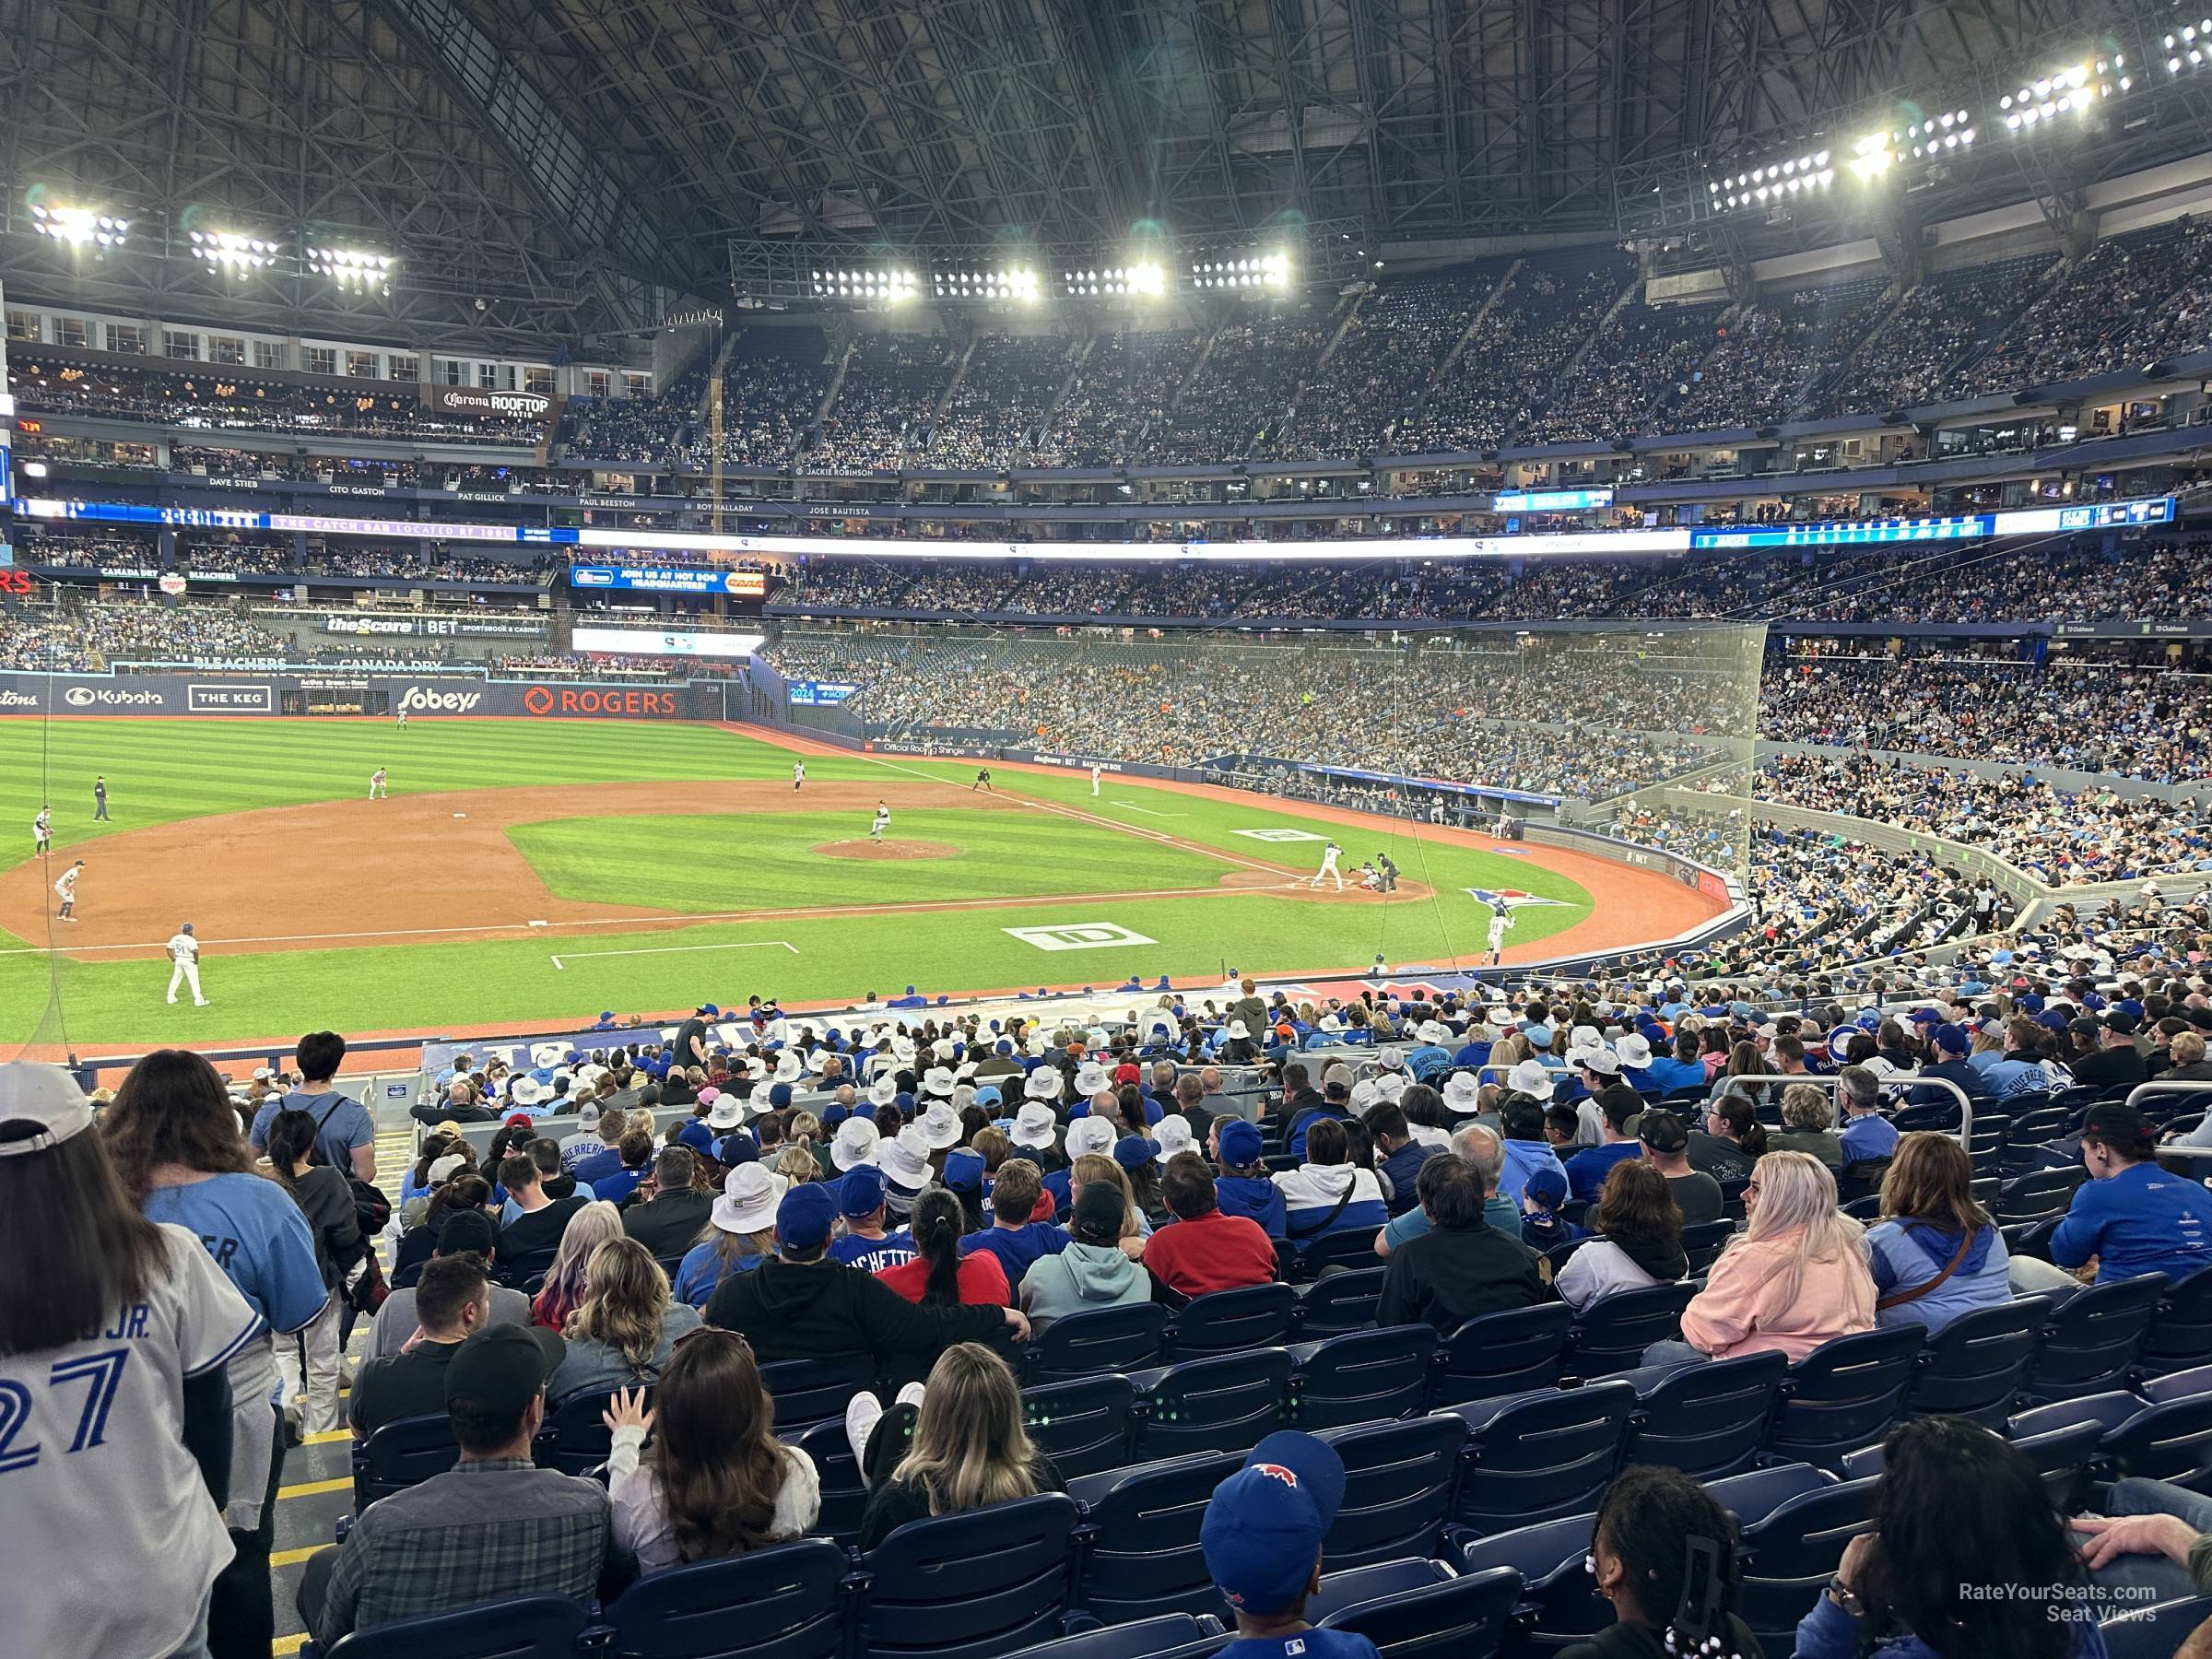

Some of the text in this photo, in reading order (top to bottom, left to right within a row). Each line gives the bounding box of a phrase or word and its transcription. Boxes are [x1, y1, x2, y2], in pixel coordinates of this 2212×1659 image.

[443, 392, 548, 413] Corona ROOFTOP
[508, 410, 533, 418] PATIO
[806, 467, 873, 477] JACKIE ROBINSON
[209, 478, 258, 488] DAVE STIEB
[329, 486, 385, 496] CITO GASTON
[458, 492, 506, 502] PAT GILLICK
[579, 498, 635, 508] PAUL BEESTON
[696, 503, 754, 512] ROY HALLADAY
[832, 507, 870, 516] BAUTISTA
[277, 518, 308, 528] THE
[313, 520, 358, 531] CATCH
[364, 522, 390, 532] BAR
[396, 524, 453, 535] LOCATED
[100, 568, 159, 577] CANADA DRY
[189, 571, 237, 580] BLEACHERS
[620, 570, 642, 579] JOIN
[646, 571, 658, 580] US
[660, 571, 673, 580] AT
[675, 572, 694, 581] HOT
[327, 615, 413, 634] theScore
[427, 620, 459, 634] BET
[463, 625, 507, 633] SPORTSBOOK
[98, 689, 164, 705] Kubota
[198, 693, 262, 703] THE KEG
[791, 688, 815, 699] 2024
[398, 686, 481, 712] Sobeys
[561, 690, 676, 714] ROGERS
[884, 743, 965, 756] Official Roog Shingle
[1065, 758, 1077, 766] BET
[1110, 763, 1122, 771] BOX
[1635, 853, 1648, 865] BET
[1022, 928, 1128, 944] TD
[105, 1303, 150, 1340] JR.
[0, 1347, 130, 1473] 27
